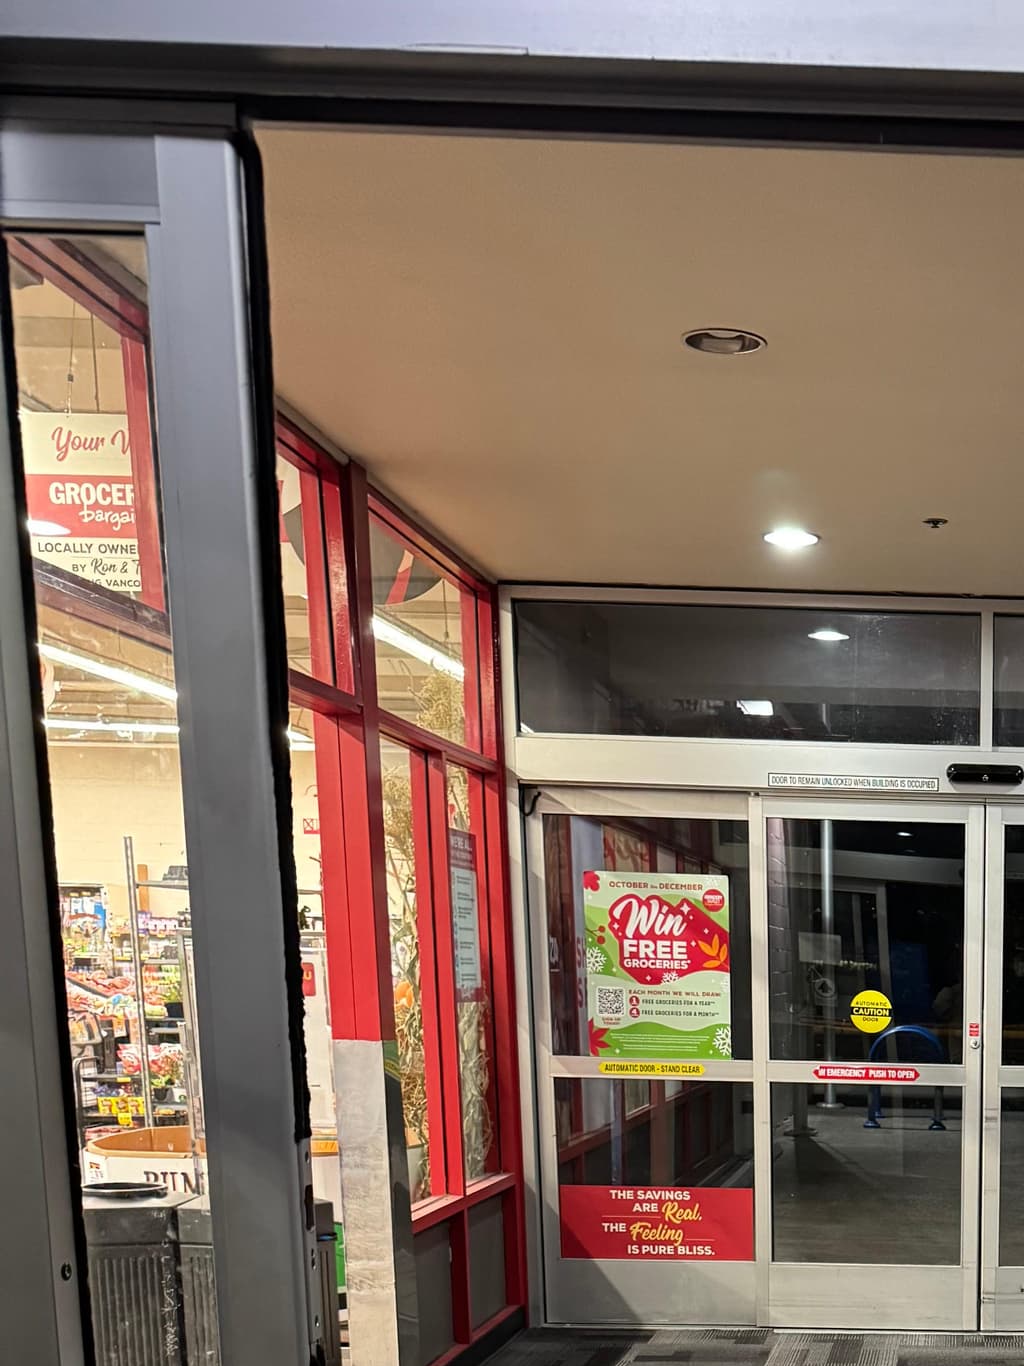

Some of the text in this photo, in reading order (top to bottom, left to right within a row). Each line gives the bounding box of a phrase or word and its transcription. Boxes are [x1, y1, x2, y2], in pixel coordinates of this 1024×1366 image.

[51, 426, 105, 461] Your
[79, 503, 136, 531] bargai
[37, 542, 136, 555] LOCALLY OWNE
[72, 564, 86, 573] BY
[91, 558, 117, 576] Ron
[120, 561, 128, 573] &
[105, 579, 141, 588] VANCO
[771, 776, 936, 789] DOOR TO REMAIN UNLOCKED WHEN BUILDING IS OCCUPIED
[609, 881, 648, 889] OCTOBER
[659, 883, 703, 891] DECEMBER
[613, 898, 687, 939] Win
[623, 939, 688, 959] FREE
[852, 1007, 889, 1016] CAUTION
[604, 1063, 638, 1072] AUTOMATIC
[640, 1064, 655, 1073] DOOR
[661, 1065, 680, 1073] STAND
[681, 1065, 700, 1073] CLEAR
[819, 1068, 915, 1079] IN EMERGENCY PUSH TO OPEN
[609, 1190, 691, 1200] THE SAVINGS
[632, 1201, 702, 1224] ARE Real.
[602, 1221, 684, 1246] THE Feeling
[627, 1245, 715, 1255] IS PURE BLISS.
